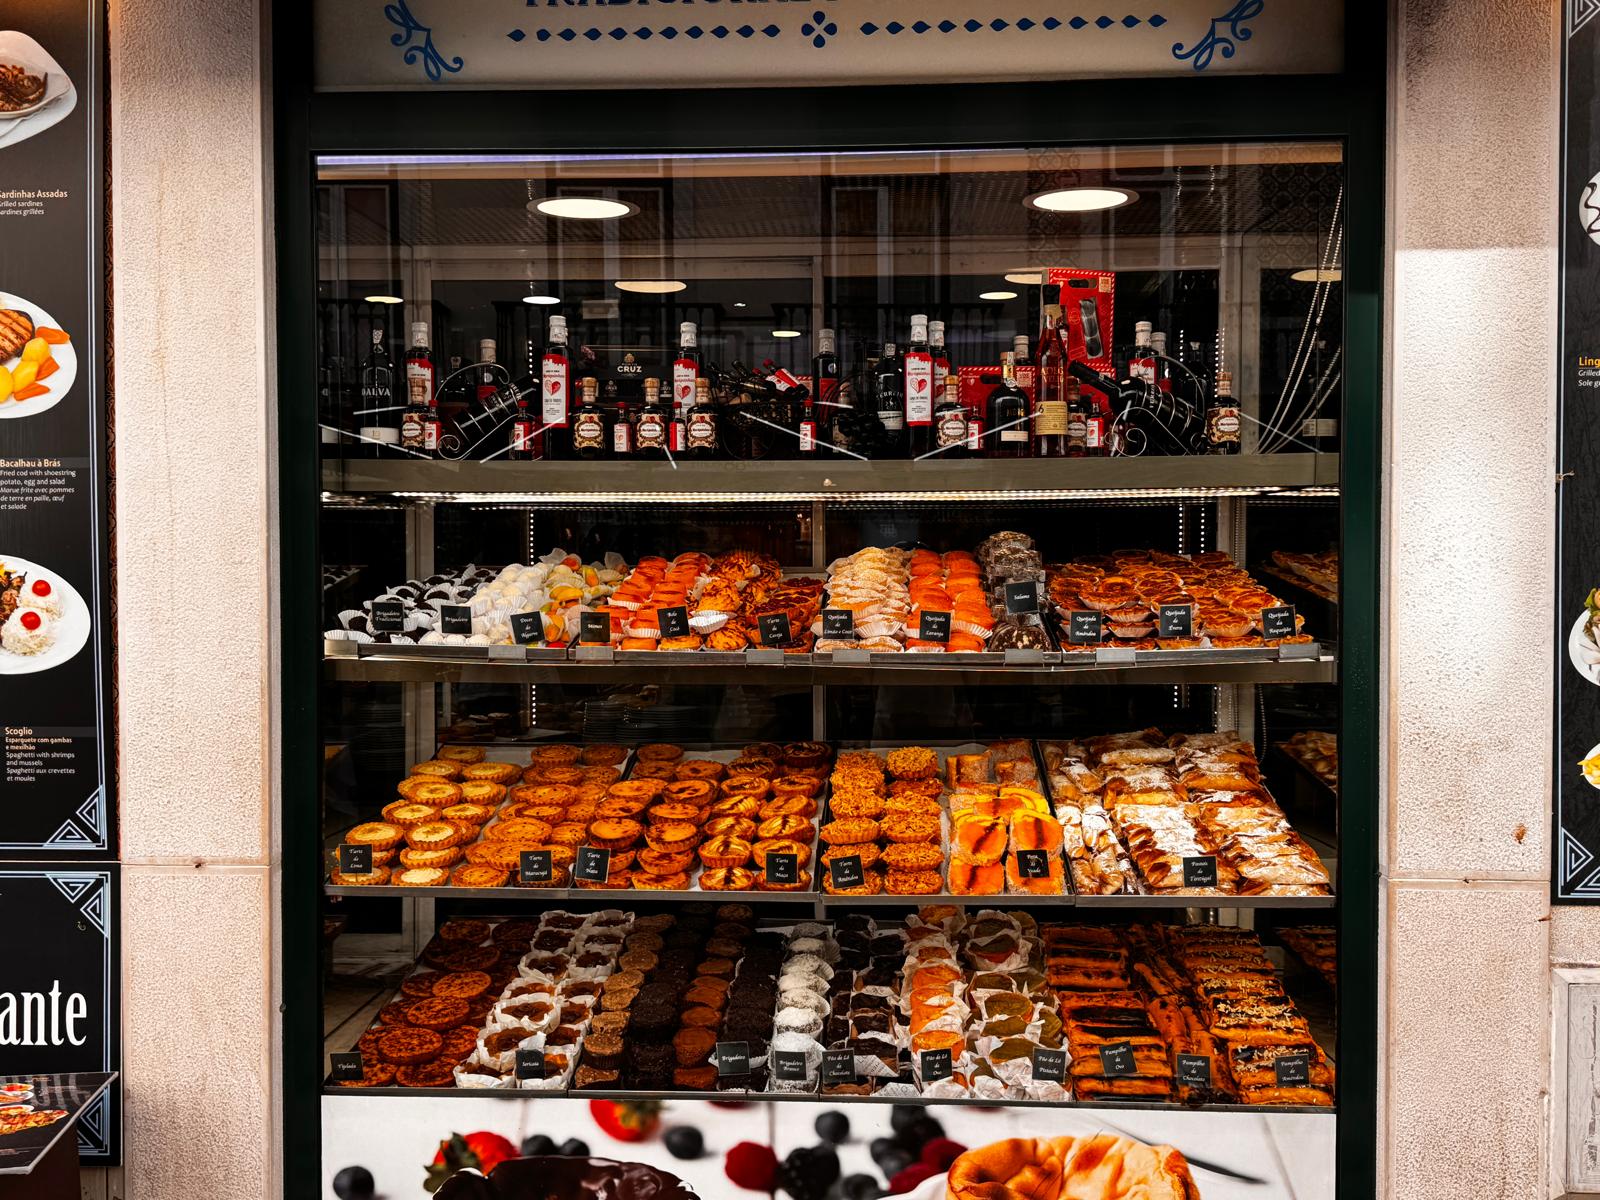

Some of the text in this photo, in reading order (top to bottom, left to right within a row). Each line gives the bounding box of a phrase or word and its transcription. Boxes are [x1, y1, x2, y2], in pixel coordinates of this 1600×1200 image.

[36, 189, 68, 198] Assadas
[0, 458, 37, 468] Bacalhau
[43, 458, 61, 468] Brás
[44, 470, 76, 478] shoestring
[49, 487, 75, 495] pommes
[5, 727, 33, 736] Scoglio
[6, 767, 35, 775] Spaghetti
[0, 980, 87, 1046] ante
